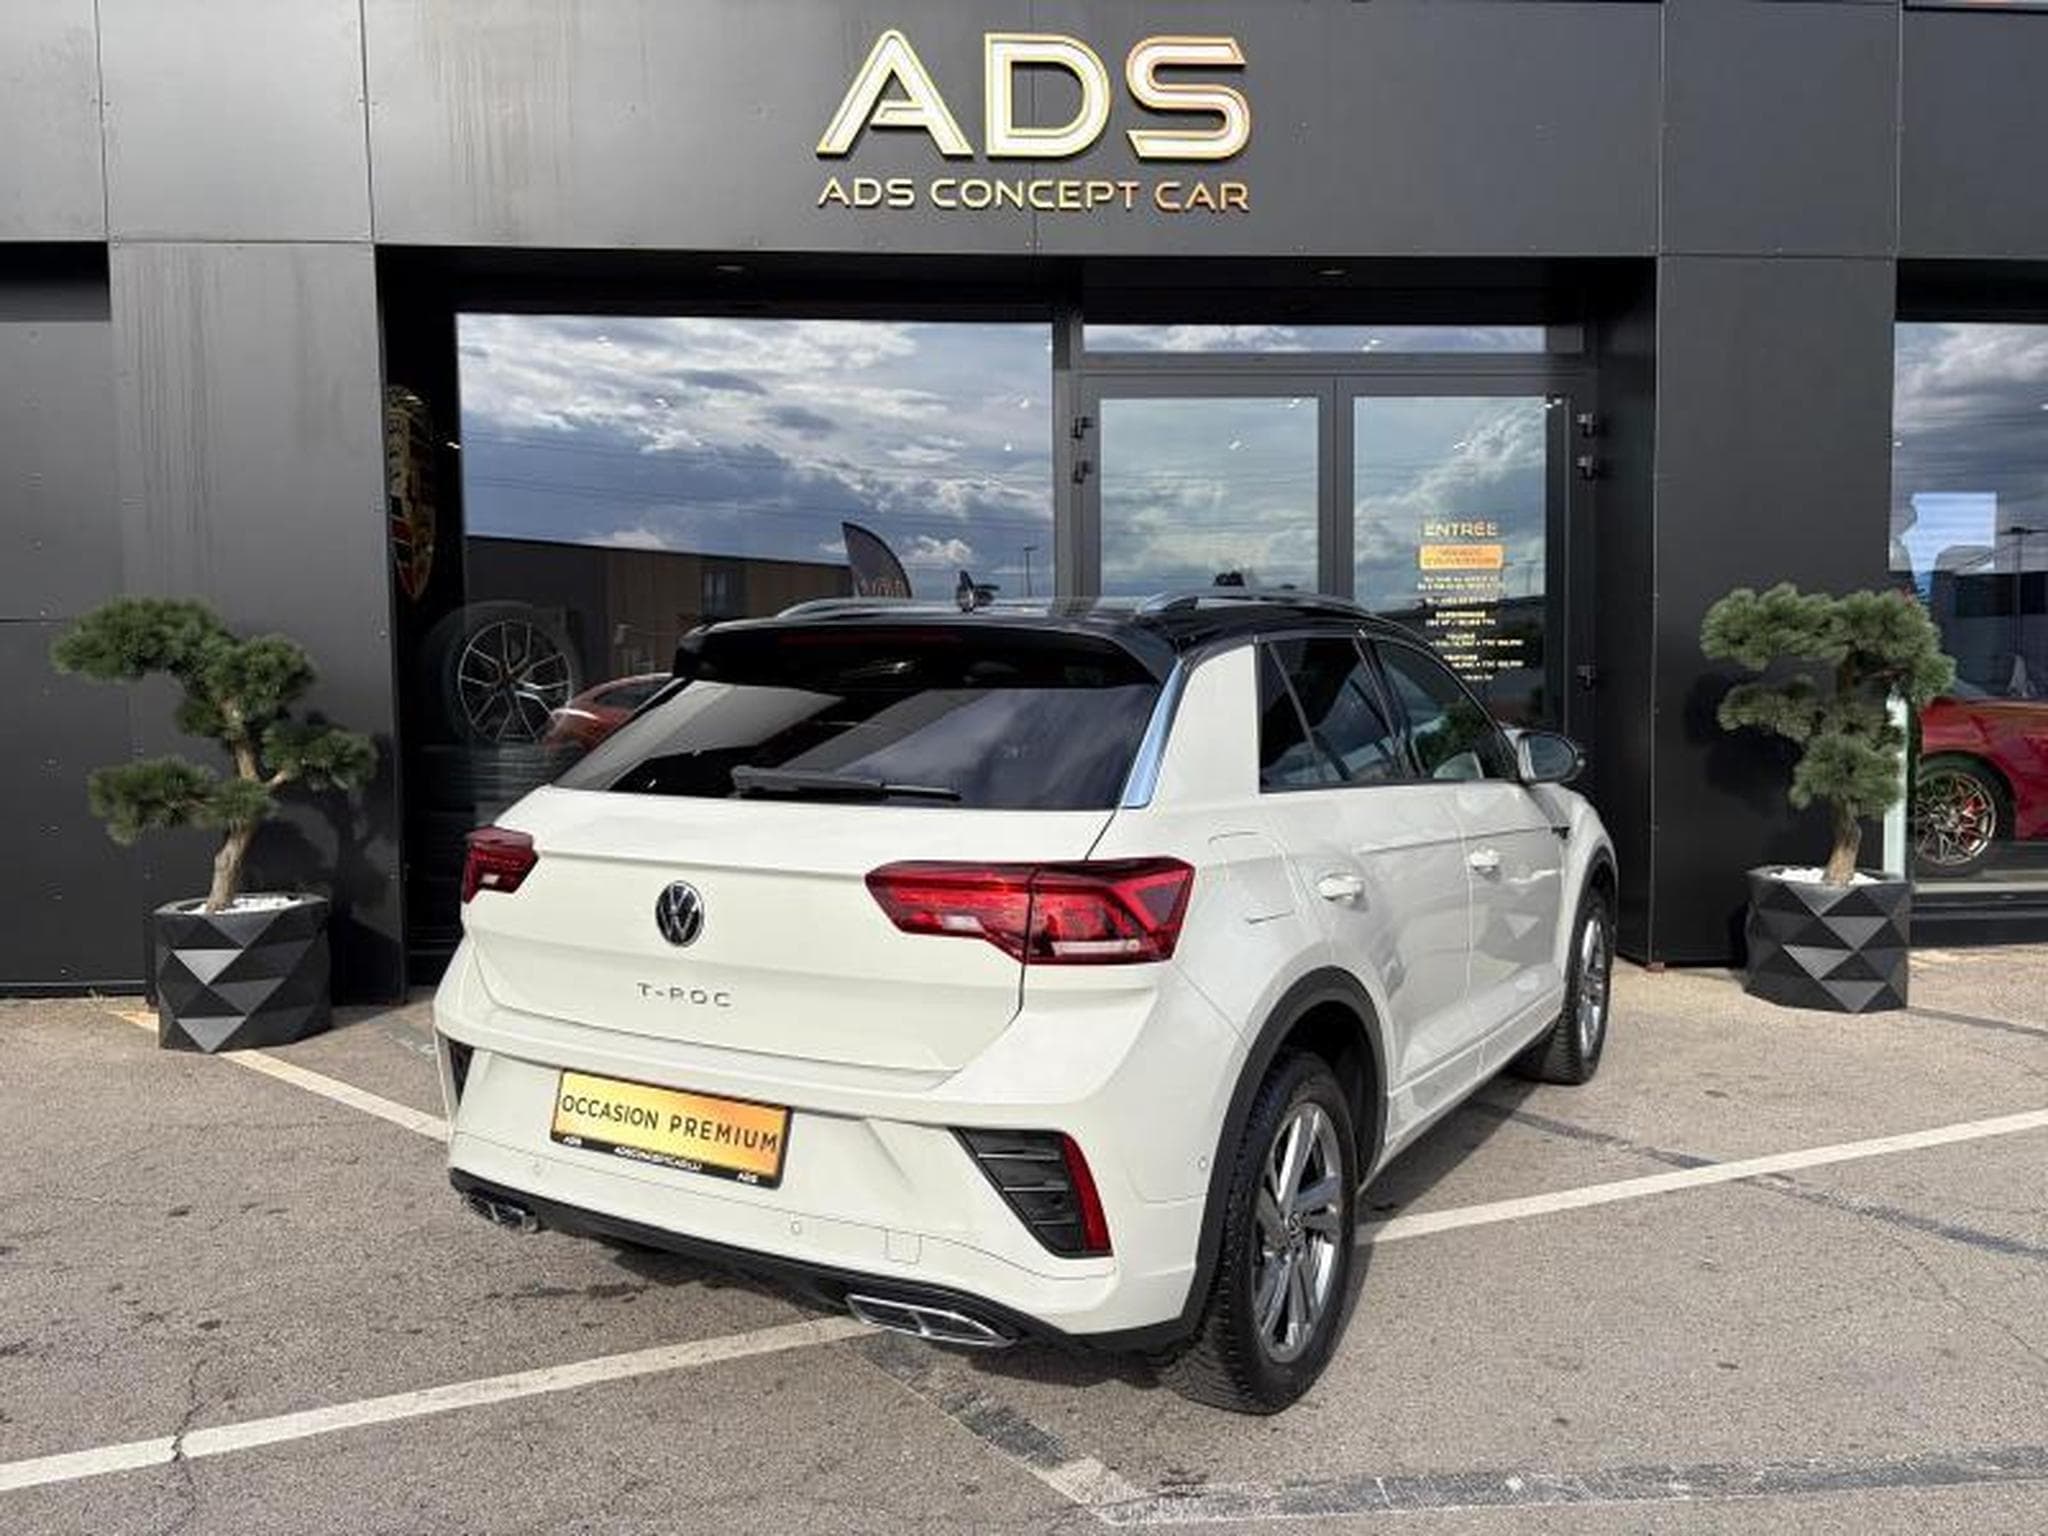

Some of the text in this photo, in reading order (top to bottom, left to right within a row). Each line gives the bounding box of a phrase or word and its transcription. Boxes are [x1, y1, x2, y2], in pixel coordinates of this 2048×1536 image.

[815, 28, 1252, 160] ADS
[816, 177, 1250, 212] ADS CONCEPT CAR
[561, 1094, 779, 1153] OCCASION PREMIUM
